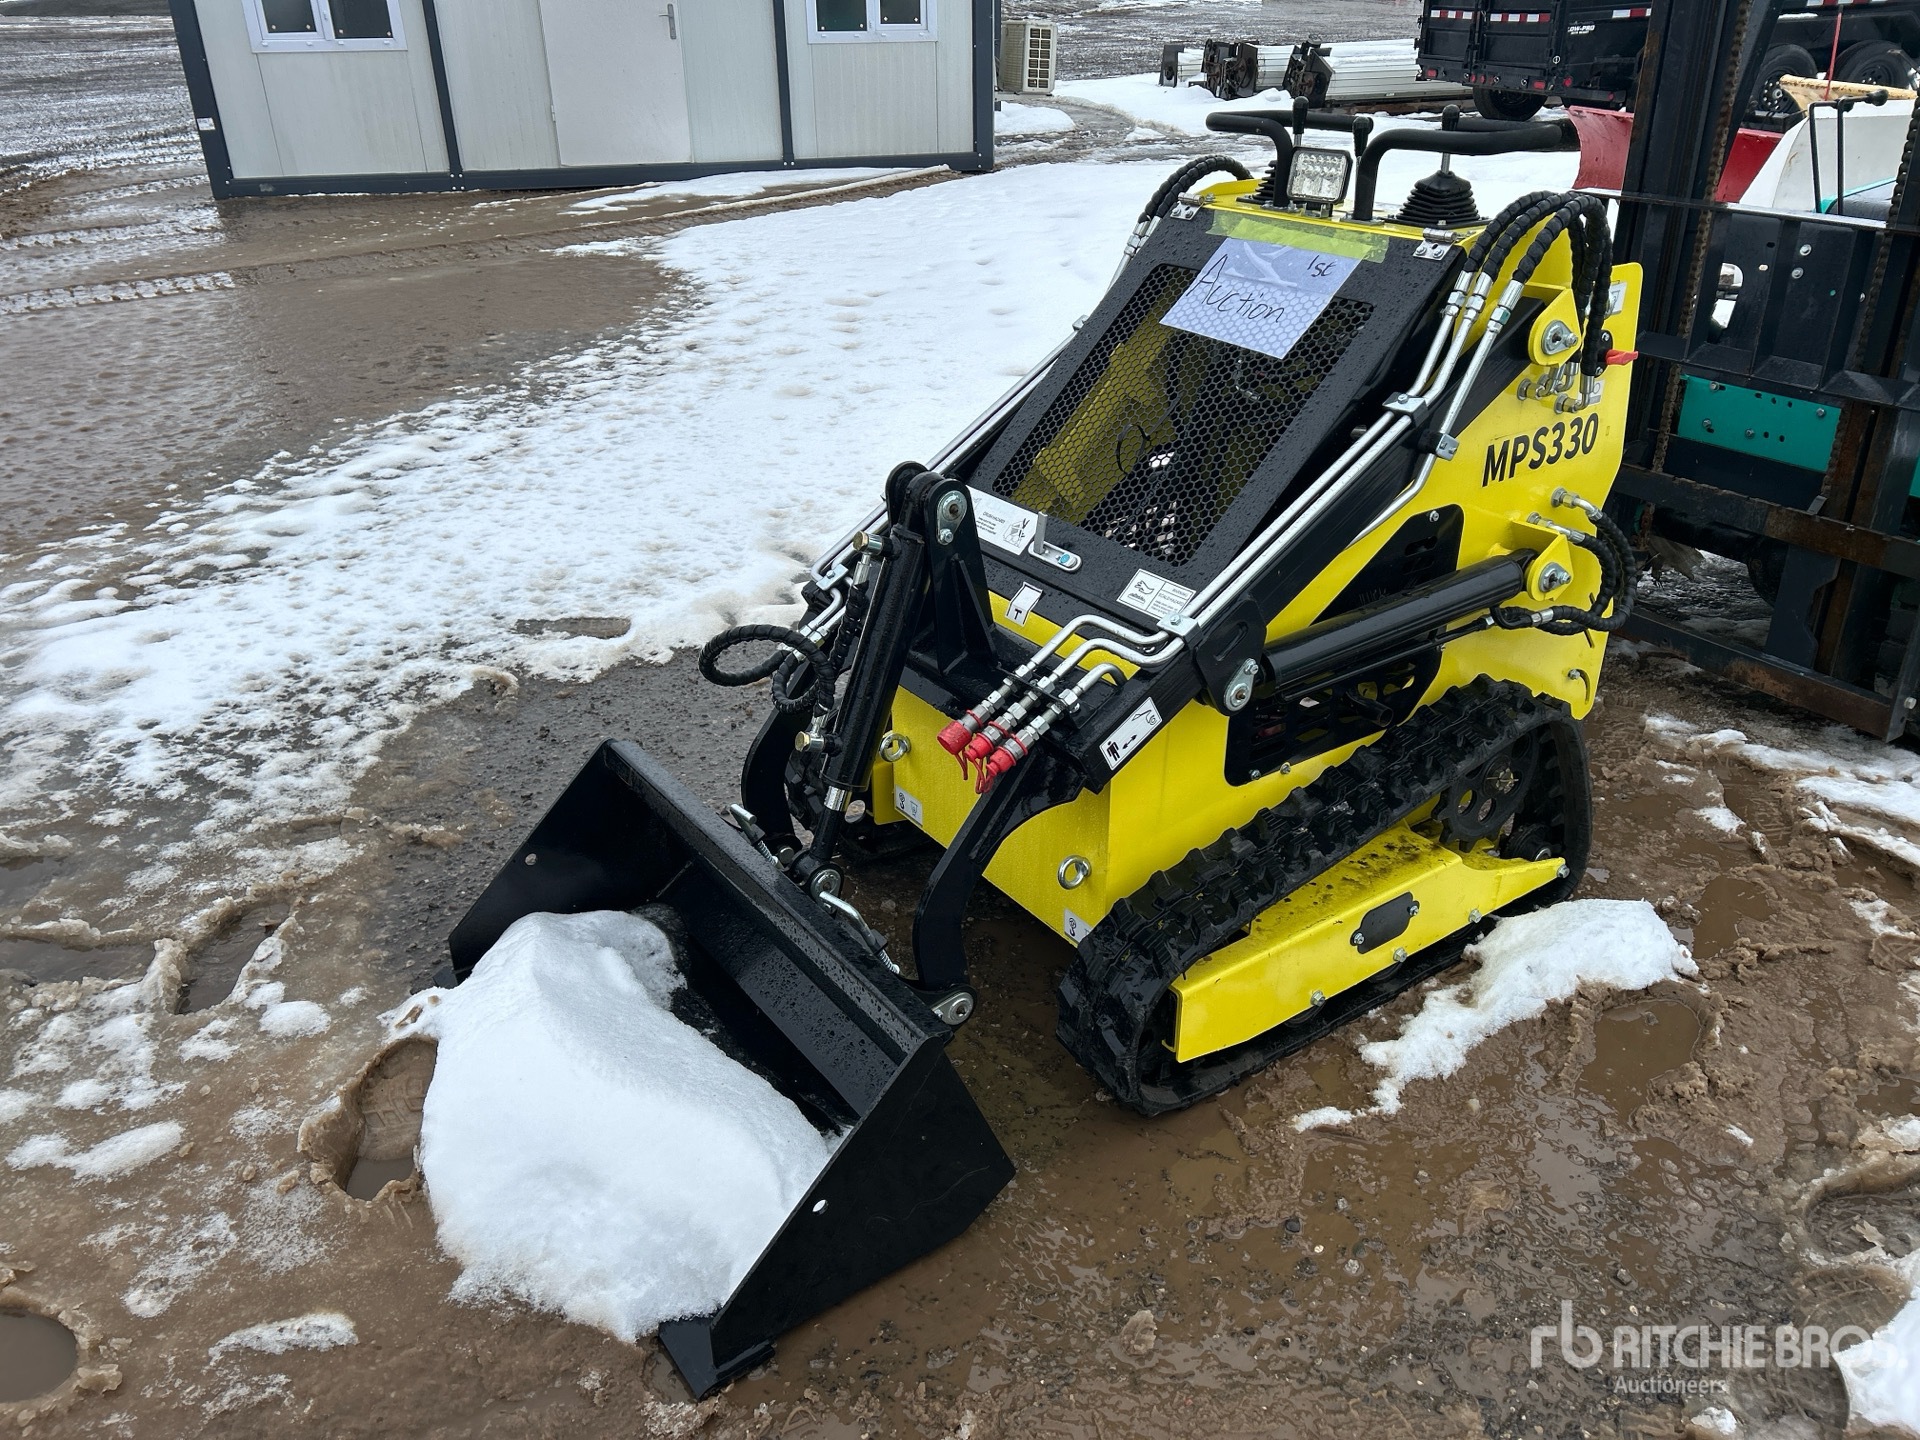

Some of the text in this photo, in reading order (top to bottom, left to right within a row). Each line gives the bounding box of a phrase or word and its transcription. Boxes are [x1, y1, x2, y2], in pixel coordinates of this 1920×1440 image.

[1185, 253, 1285, 323] Auction
[1307, 254, 1336, 278] 1st
[1482, 412, 1599, 487] MPS330
